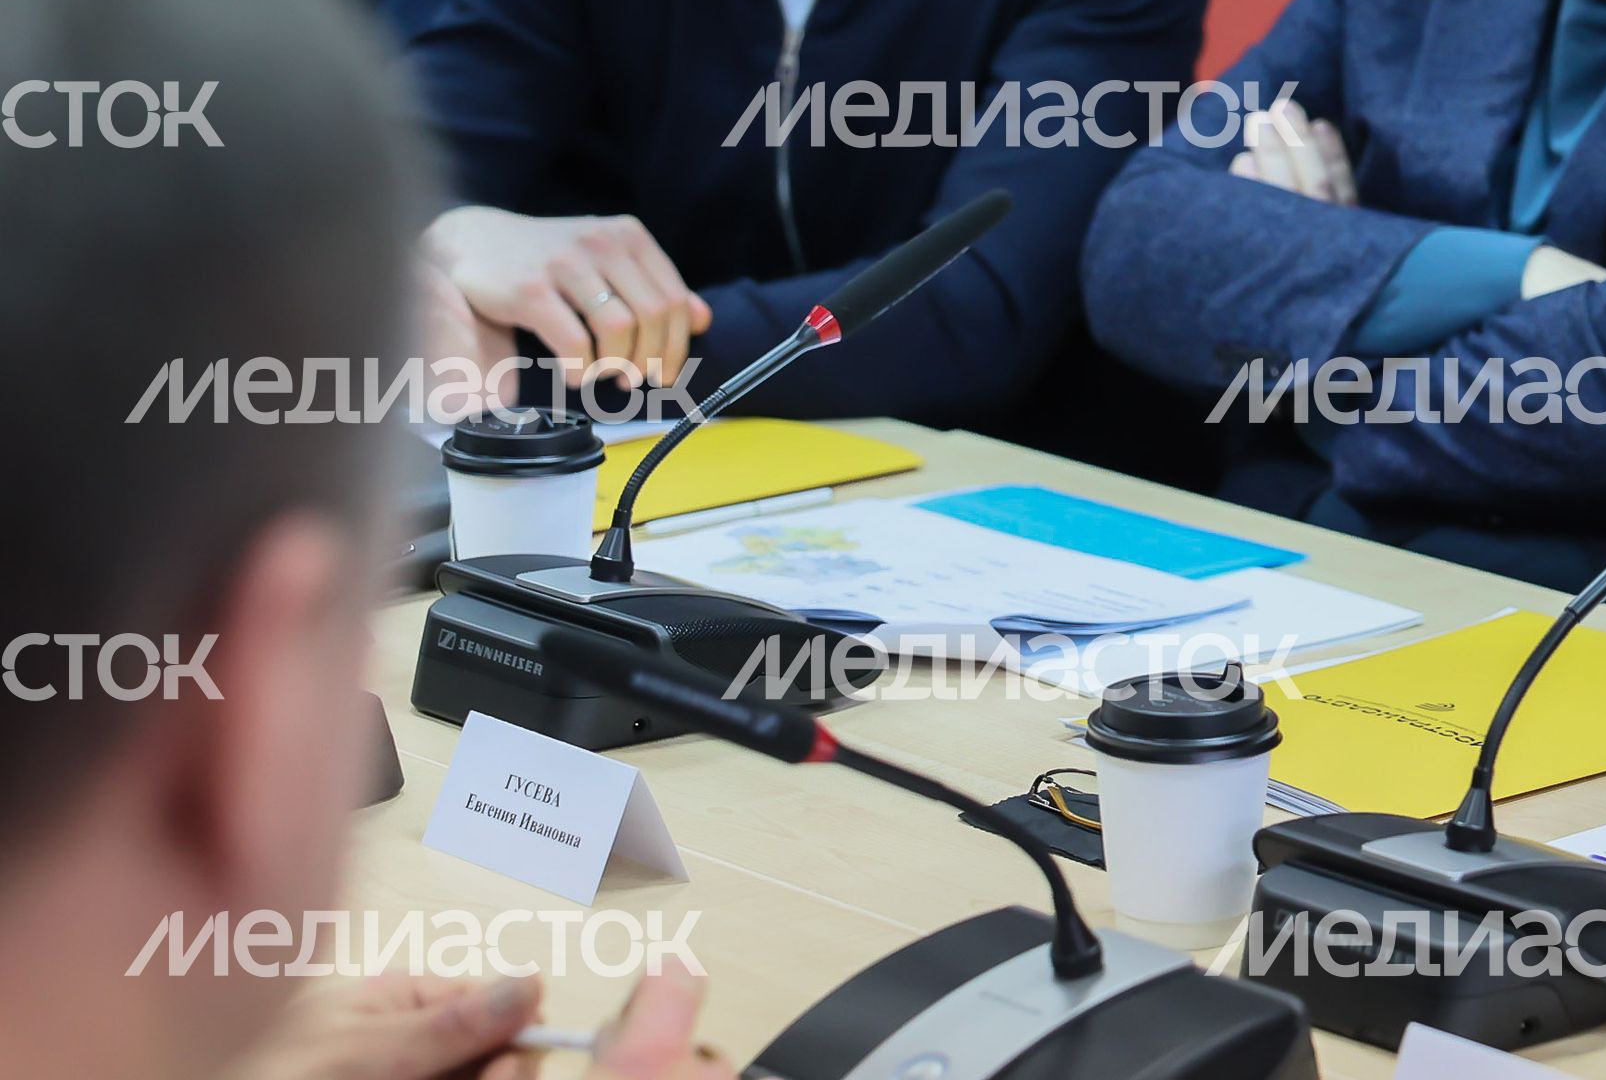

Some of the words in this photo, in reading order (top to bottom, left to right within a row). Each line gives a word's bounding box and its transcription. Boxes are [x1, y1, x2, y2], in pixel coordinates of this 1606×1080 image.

[459, 638, 543, 676] SENNHEISER
[504, 774, 560, 808] ГУСЕВА
[465, 793, 517, 825] Евгения
[519, 812, 581, 848] Ивановна
